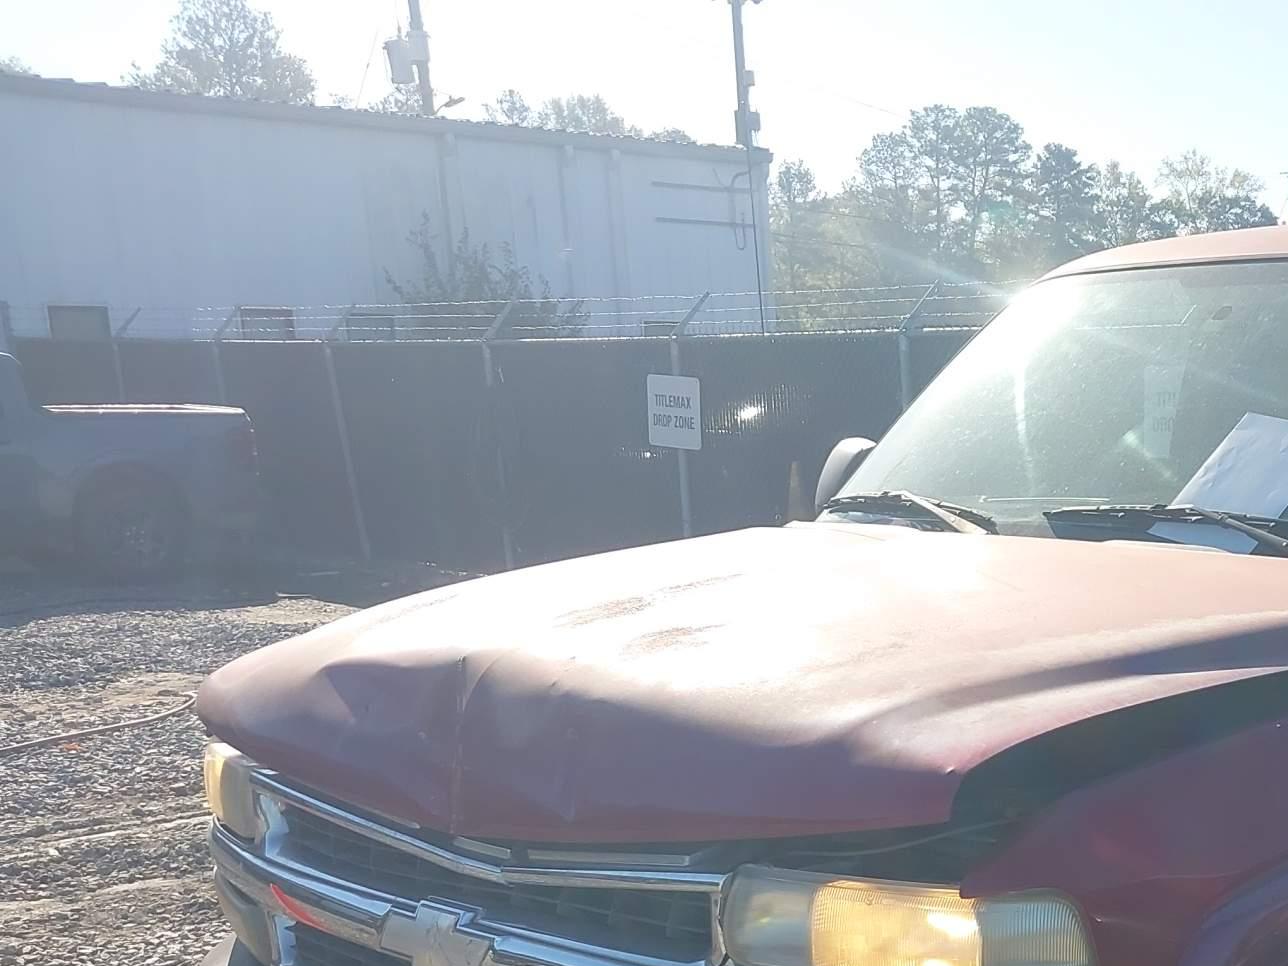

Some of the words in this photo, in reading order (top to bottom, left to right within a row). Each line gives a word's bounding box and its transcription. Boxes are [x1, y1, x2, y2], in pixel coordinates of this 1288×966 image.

[655, 394, 691, 409] TITLEMAX
[653, 413, 672, 428] DROP
[674, 415, 696, 430] ZONE
